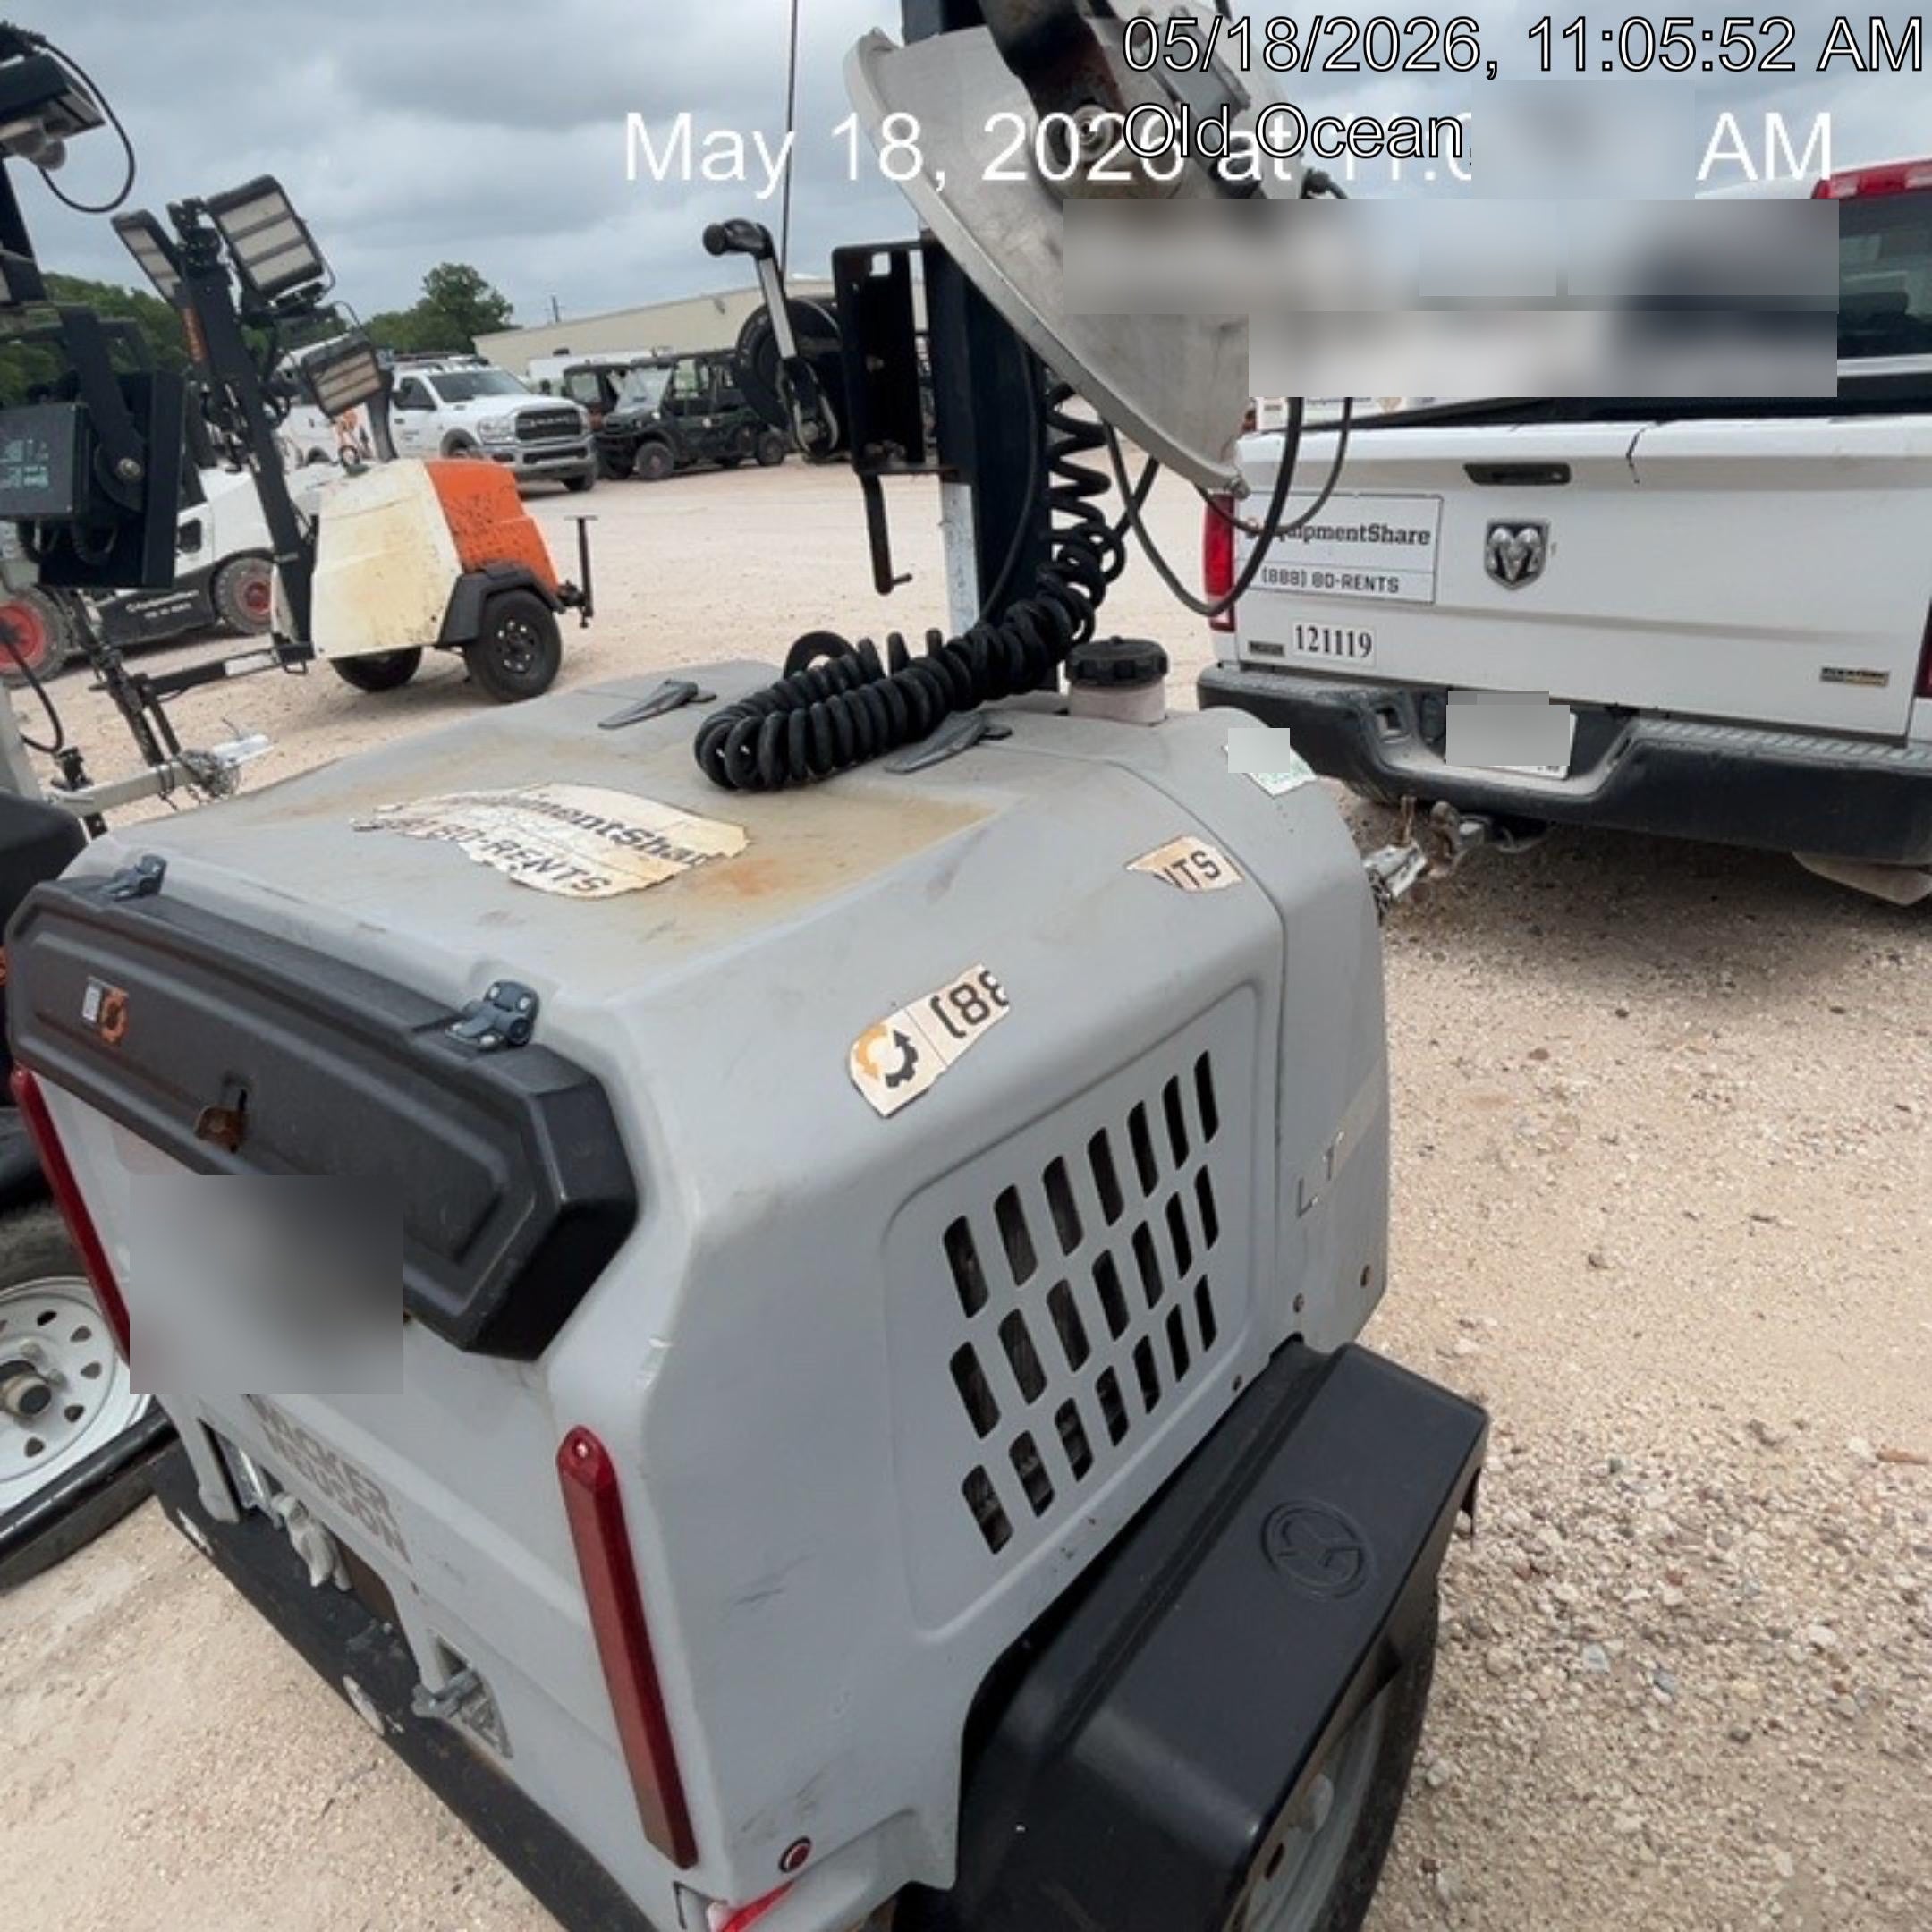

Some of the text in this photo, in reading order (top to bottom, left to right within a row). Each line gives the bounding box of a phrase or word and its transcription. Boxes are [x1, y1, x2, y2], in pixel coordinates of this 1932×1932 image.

[1274, 522, 1432, 546] uipmentShare
[1261, 567, 1400, 594] (888) 80-RENTS
[1295, 624, 1374, 658] 121119
